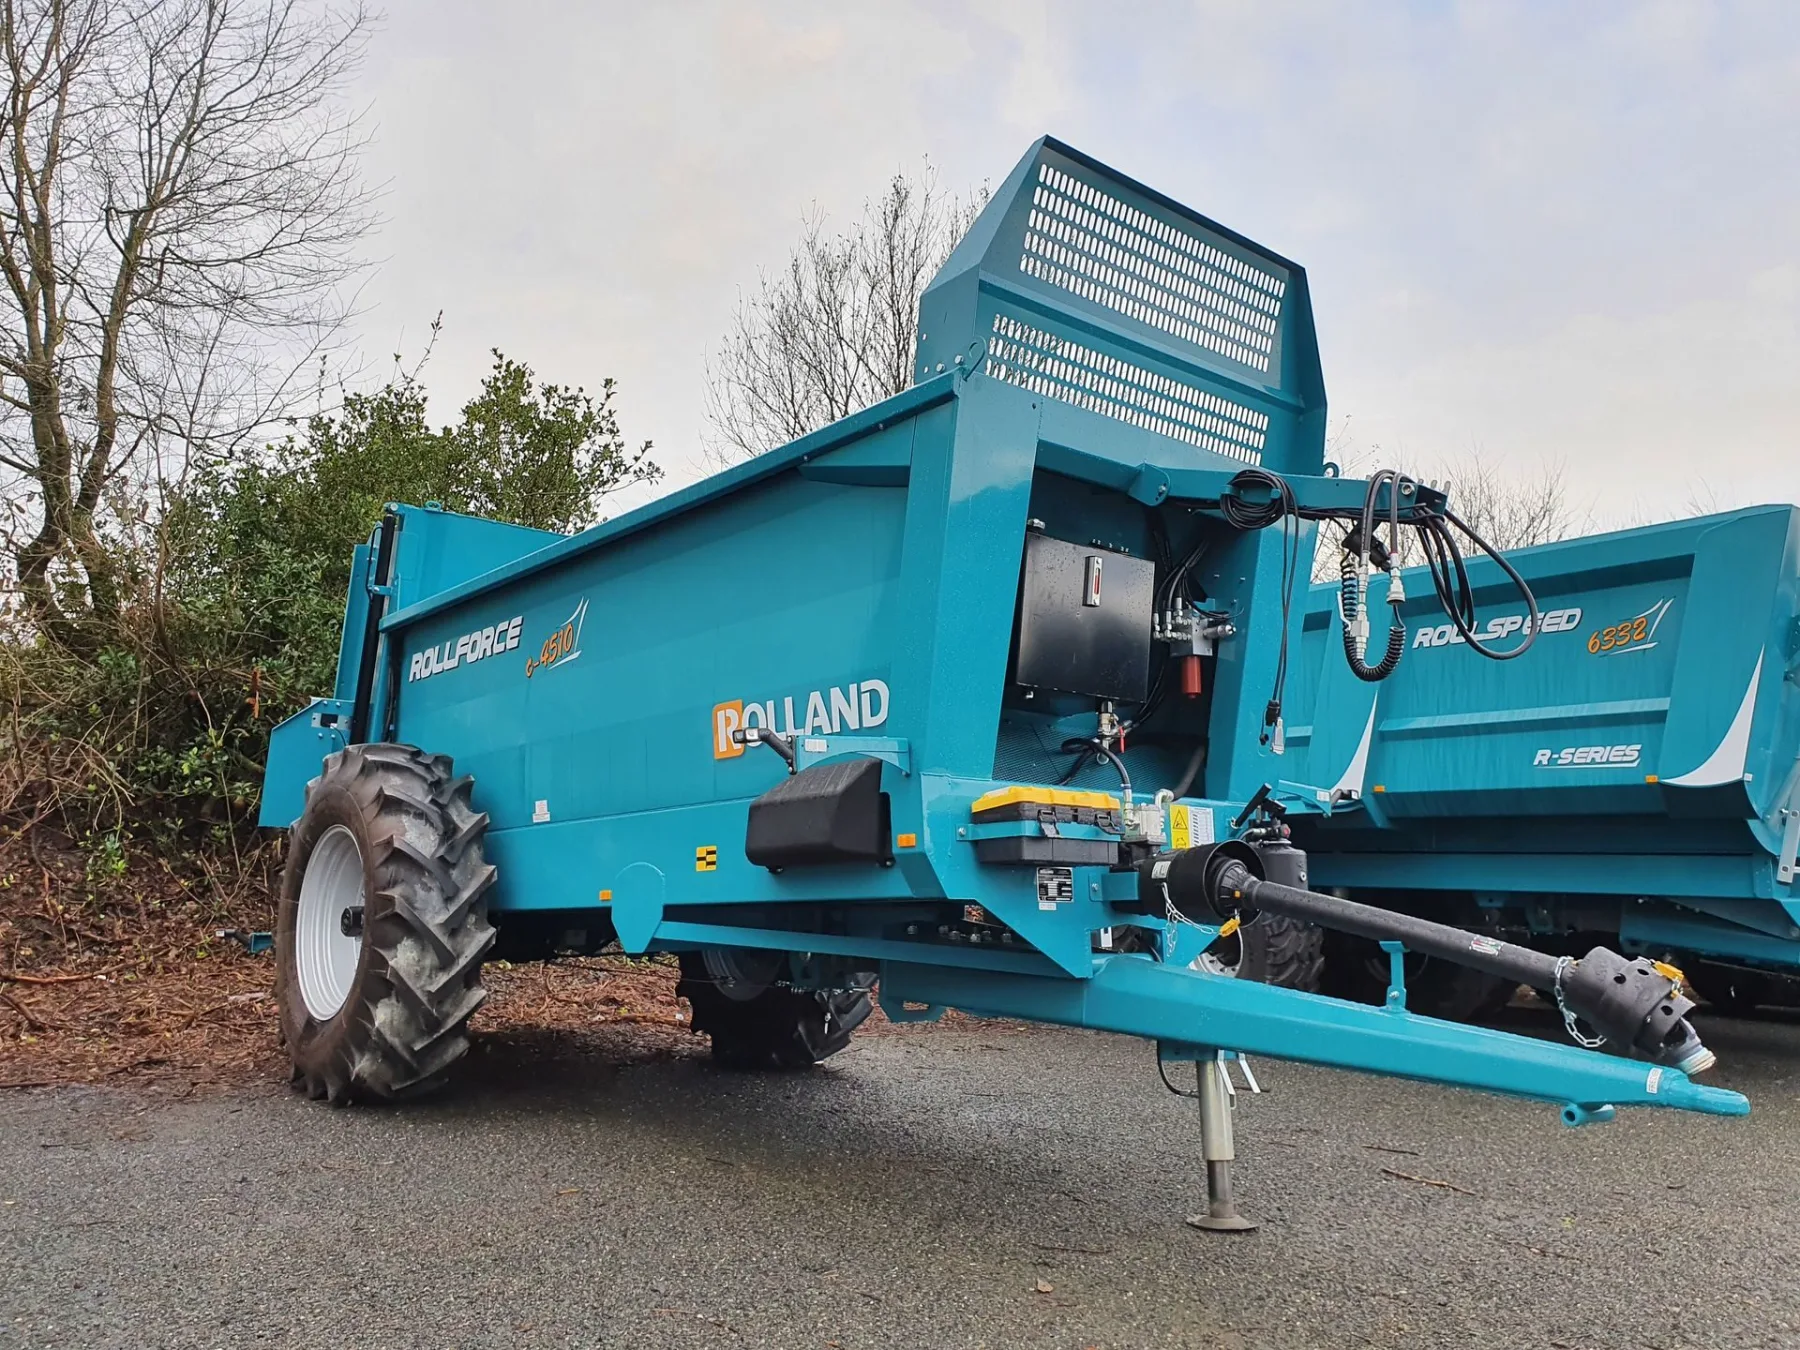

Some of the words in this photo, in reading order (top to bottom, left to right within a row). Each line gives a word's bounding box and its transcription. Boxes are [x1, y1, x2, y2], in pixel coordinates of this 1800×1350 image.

[408, 616, 524, 683] ROLLFORCE
[1412, 608, 1583, 649] ROLLSPEED
[1588, 617, 1648, 655] 6332
[713, 679, 890, 754] ROLLAND
[1533, 745, 1642, 765] R-SERIES
